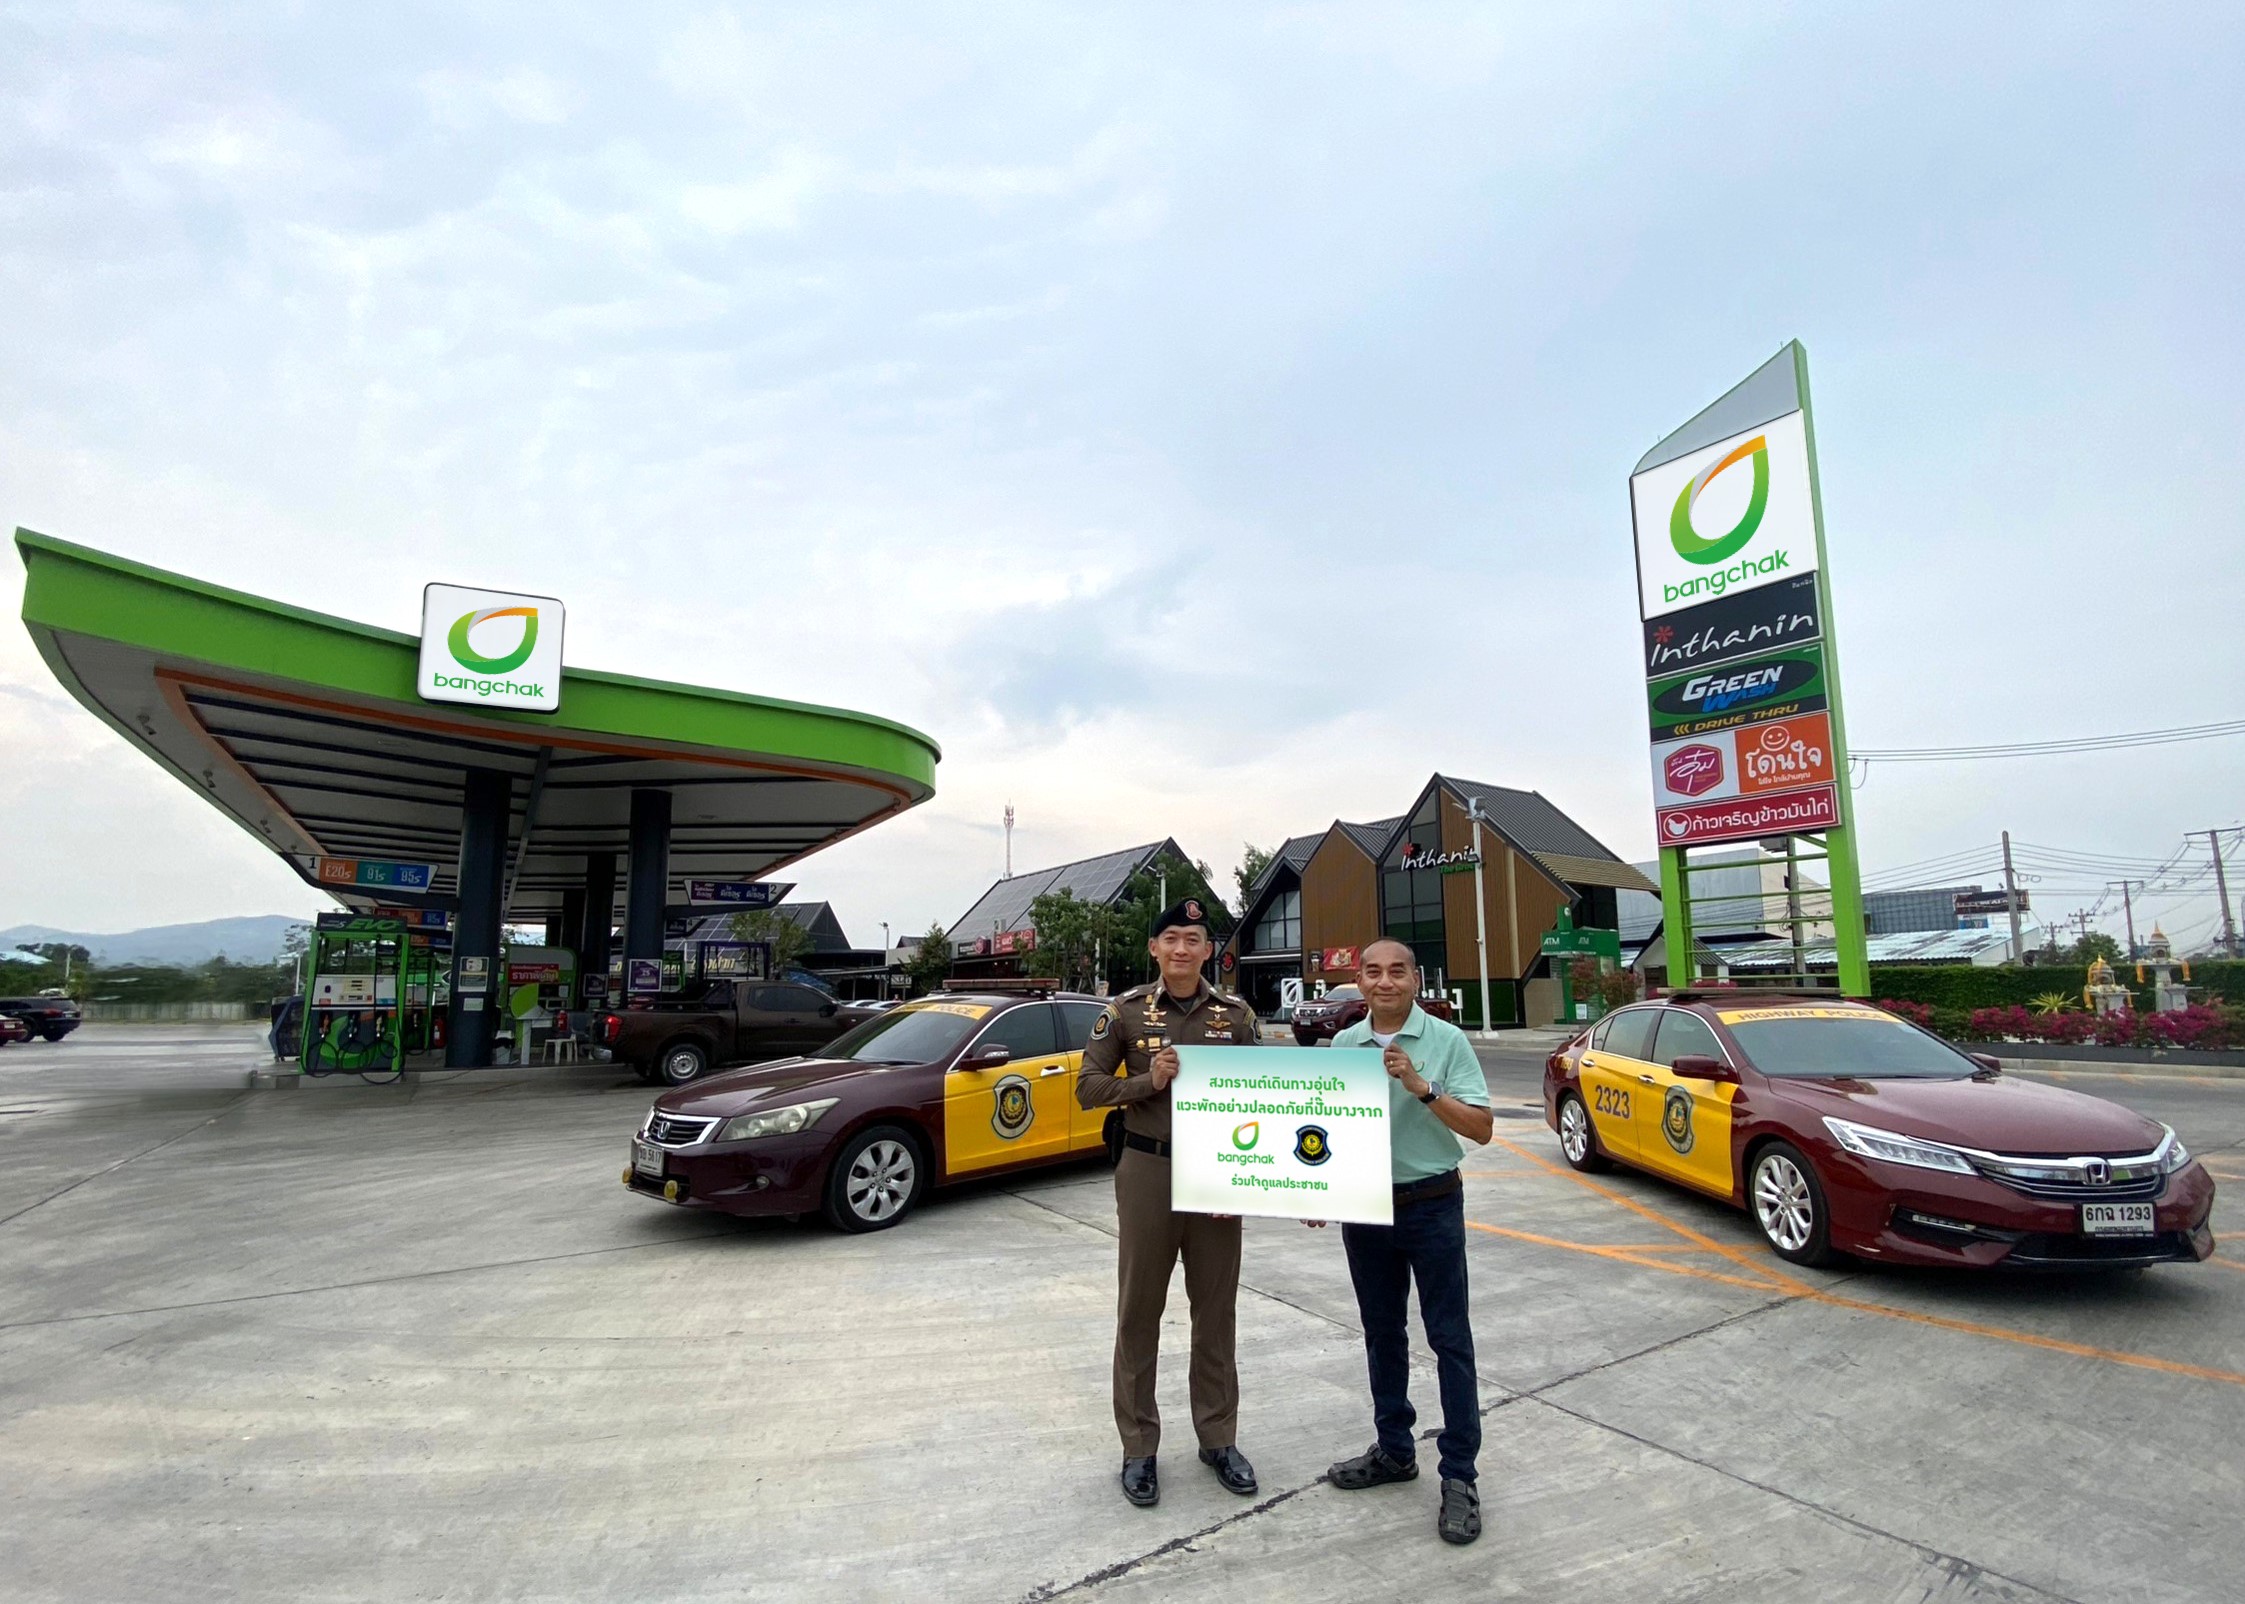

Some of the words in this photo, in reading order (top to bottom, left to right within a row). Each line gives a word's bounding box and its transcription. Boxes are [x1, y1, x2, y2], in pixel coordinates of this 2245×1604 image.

[1663, 549, 1790, 603] bangchak
[1650, 613, 1814, 667] Inthanin
[433, 672, 545, 698] bangchak
[1682, 665, 1783, 702] GREEN
[1694, 714, 1745, 732] DRIVE
[1752, 703, 1799, 721] THRU
[1745, 740, 1822, 778] โดนใจ
[1692, 797, 1829, 831] ก้าวเจริญข้าวมันไก่
[770, 884, 777, 895] 2
[346, 918, 400, 930] EVO
[1544, 937, 1560, 946] ATM
[1737, 1009, 1815, 1021] HIGHWAY
[1209, 1075, 1345, 1096] สงกรานต์เดินทางอุ่นใจ
[1176, 1096, 1383, 1119] แวะพักอย่างปลอดภัยที่ปั๊มบางจาก
[1595, 1084, 1631, 1119] 2323
[1217, 1151, 1275, 1167] bangchak
[1231, 1173, 1328, 1191] ร่วมใจดูแลประชาชน
[2119, 1206, 2151, 1221] 1293
